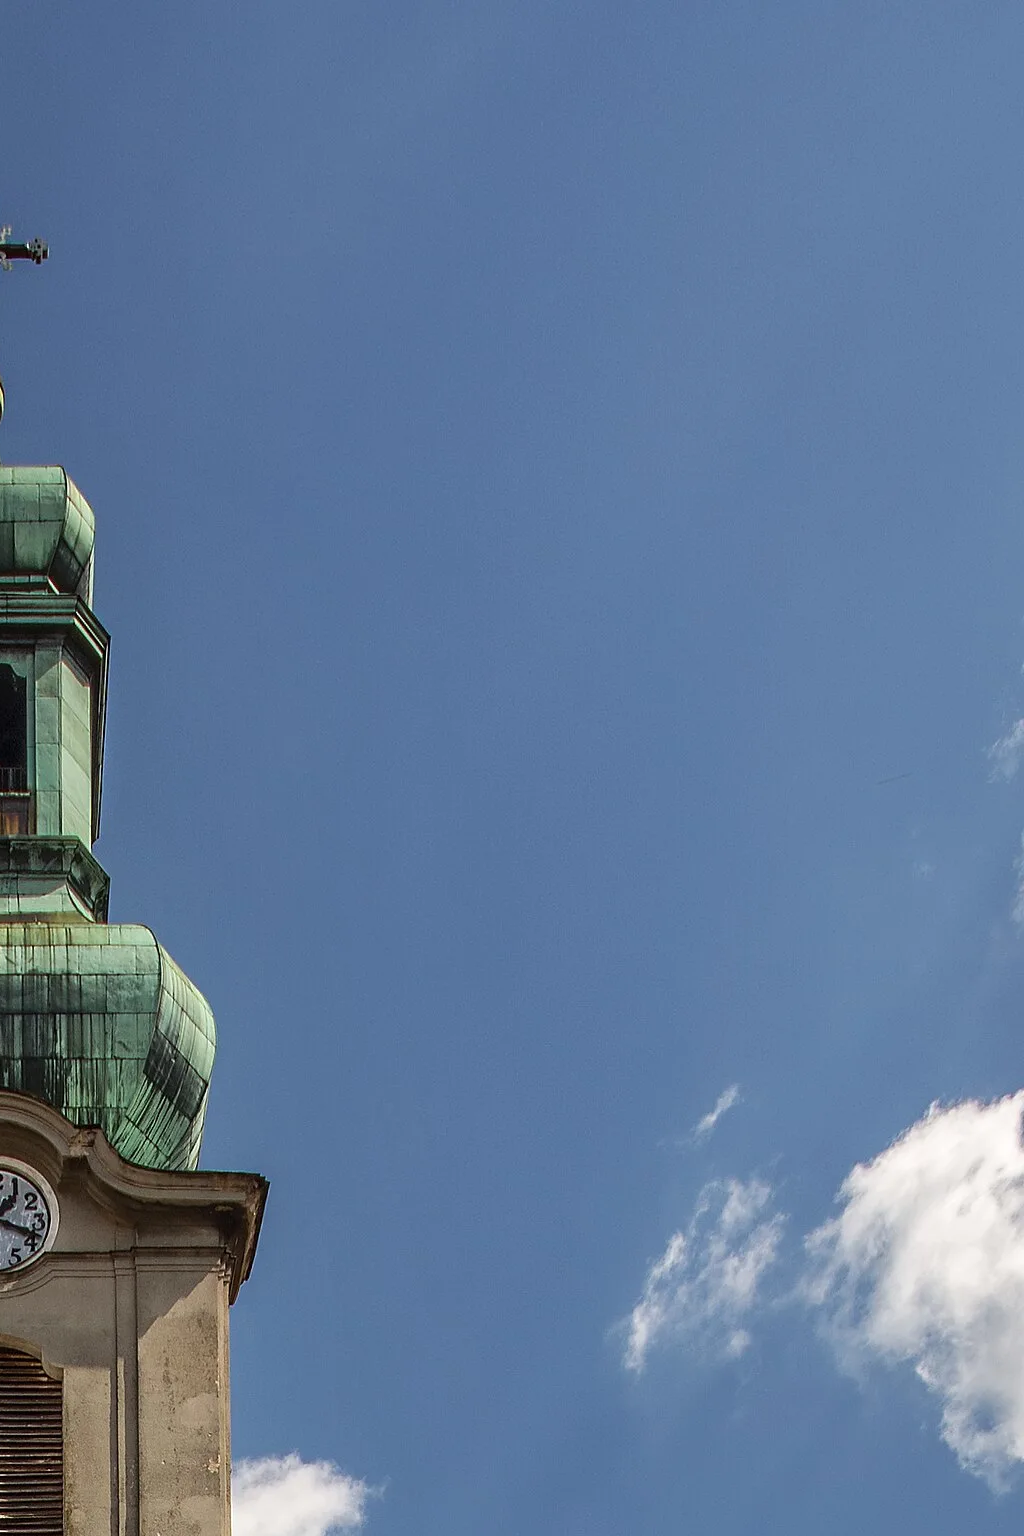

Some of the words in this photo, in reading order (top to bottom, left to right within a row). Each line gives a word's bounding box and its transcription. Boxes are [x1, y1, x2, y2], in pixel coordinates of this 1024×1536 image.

[12, 1177, 19, 1195] 1
[24, 1192, 38, 1211] 2
[32, 1212, 46, 1231] 3
[24, 1229, 38, 1252] 4
[9, 1248, 22, 1266] 5
